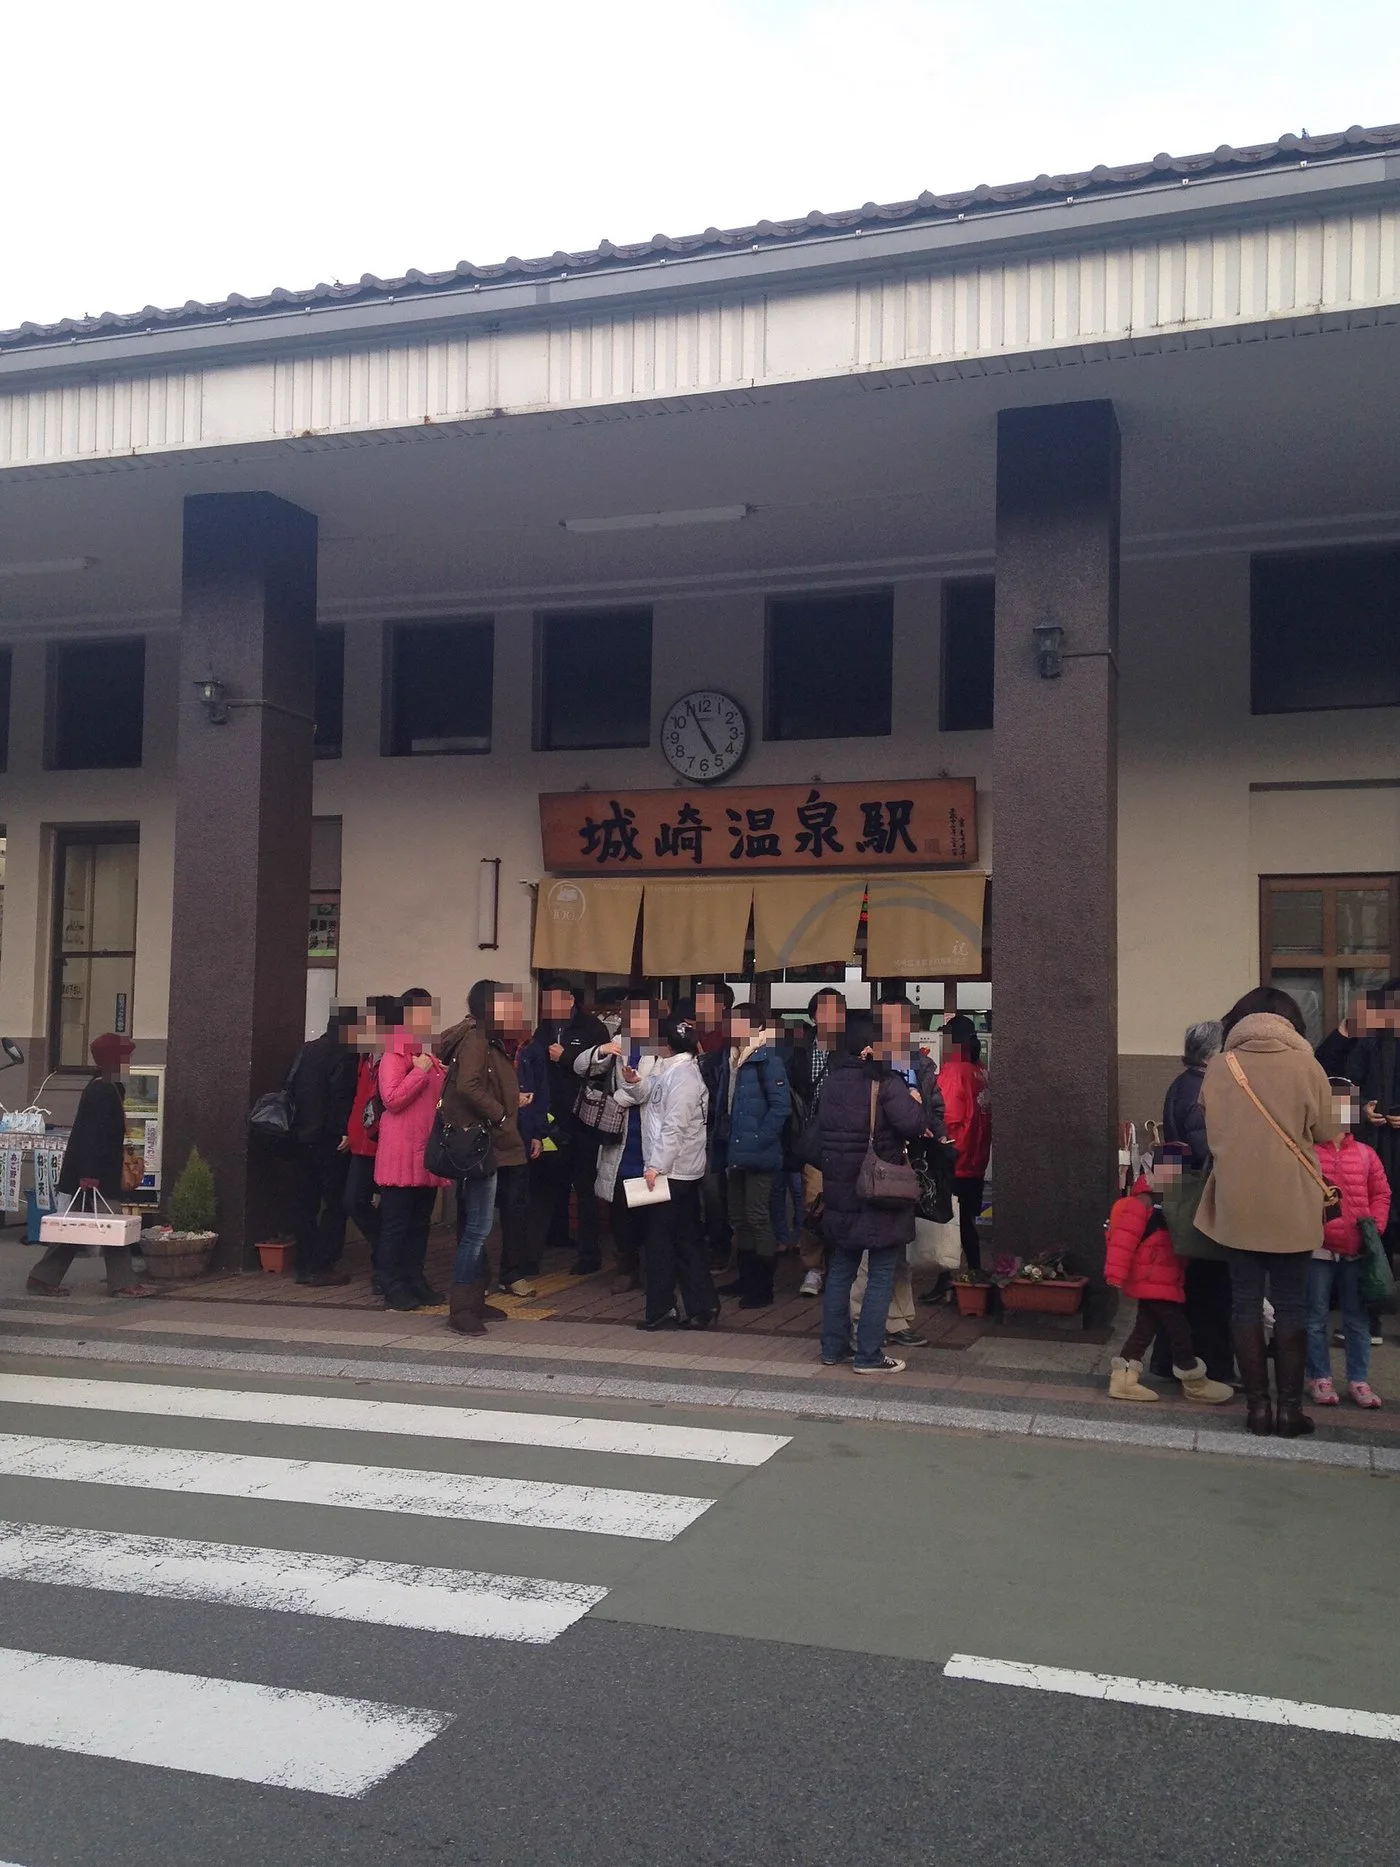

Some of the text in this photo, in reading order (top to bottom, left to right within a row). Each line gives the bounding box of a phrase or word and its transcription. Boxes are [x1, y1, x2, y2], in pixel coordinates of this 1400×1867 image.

[698, 699, 711, 713] 12
[674, 715, 686, 729] 10
[724, 711, 734, 725] 2
[670, 731, 680, 745] 9
[729, 727, 739, 740] 3
[675, 744, 685, 758] 8
[725, 742, 734, 754] 4
[687, 756, 696, 769] 7
[699, 758, 709, 772] 6
[714, 754, 724, 767] 5
[579, 789, 918, 864] 城崎温泉駅
